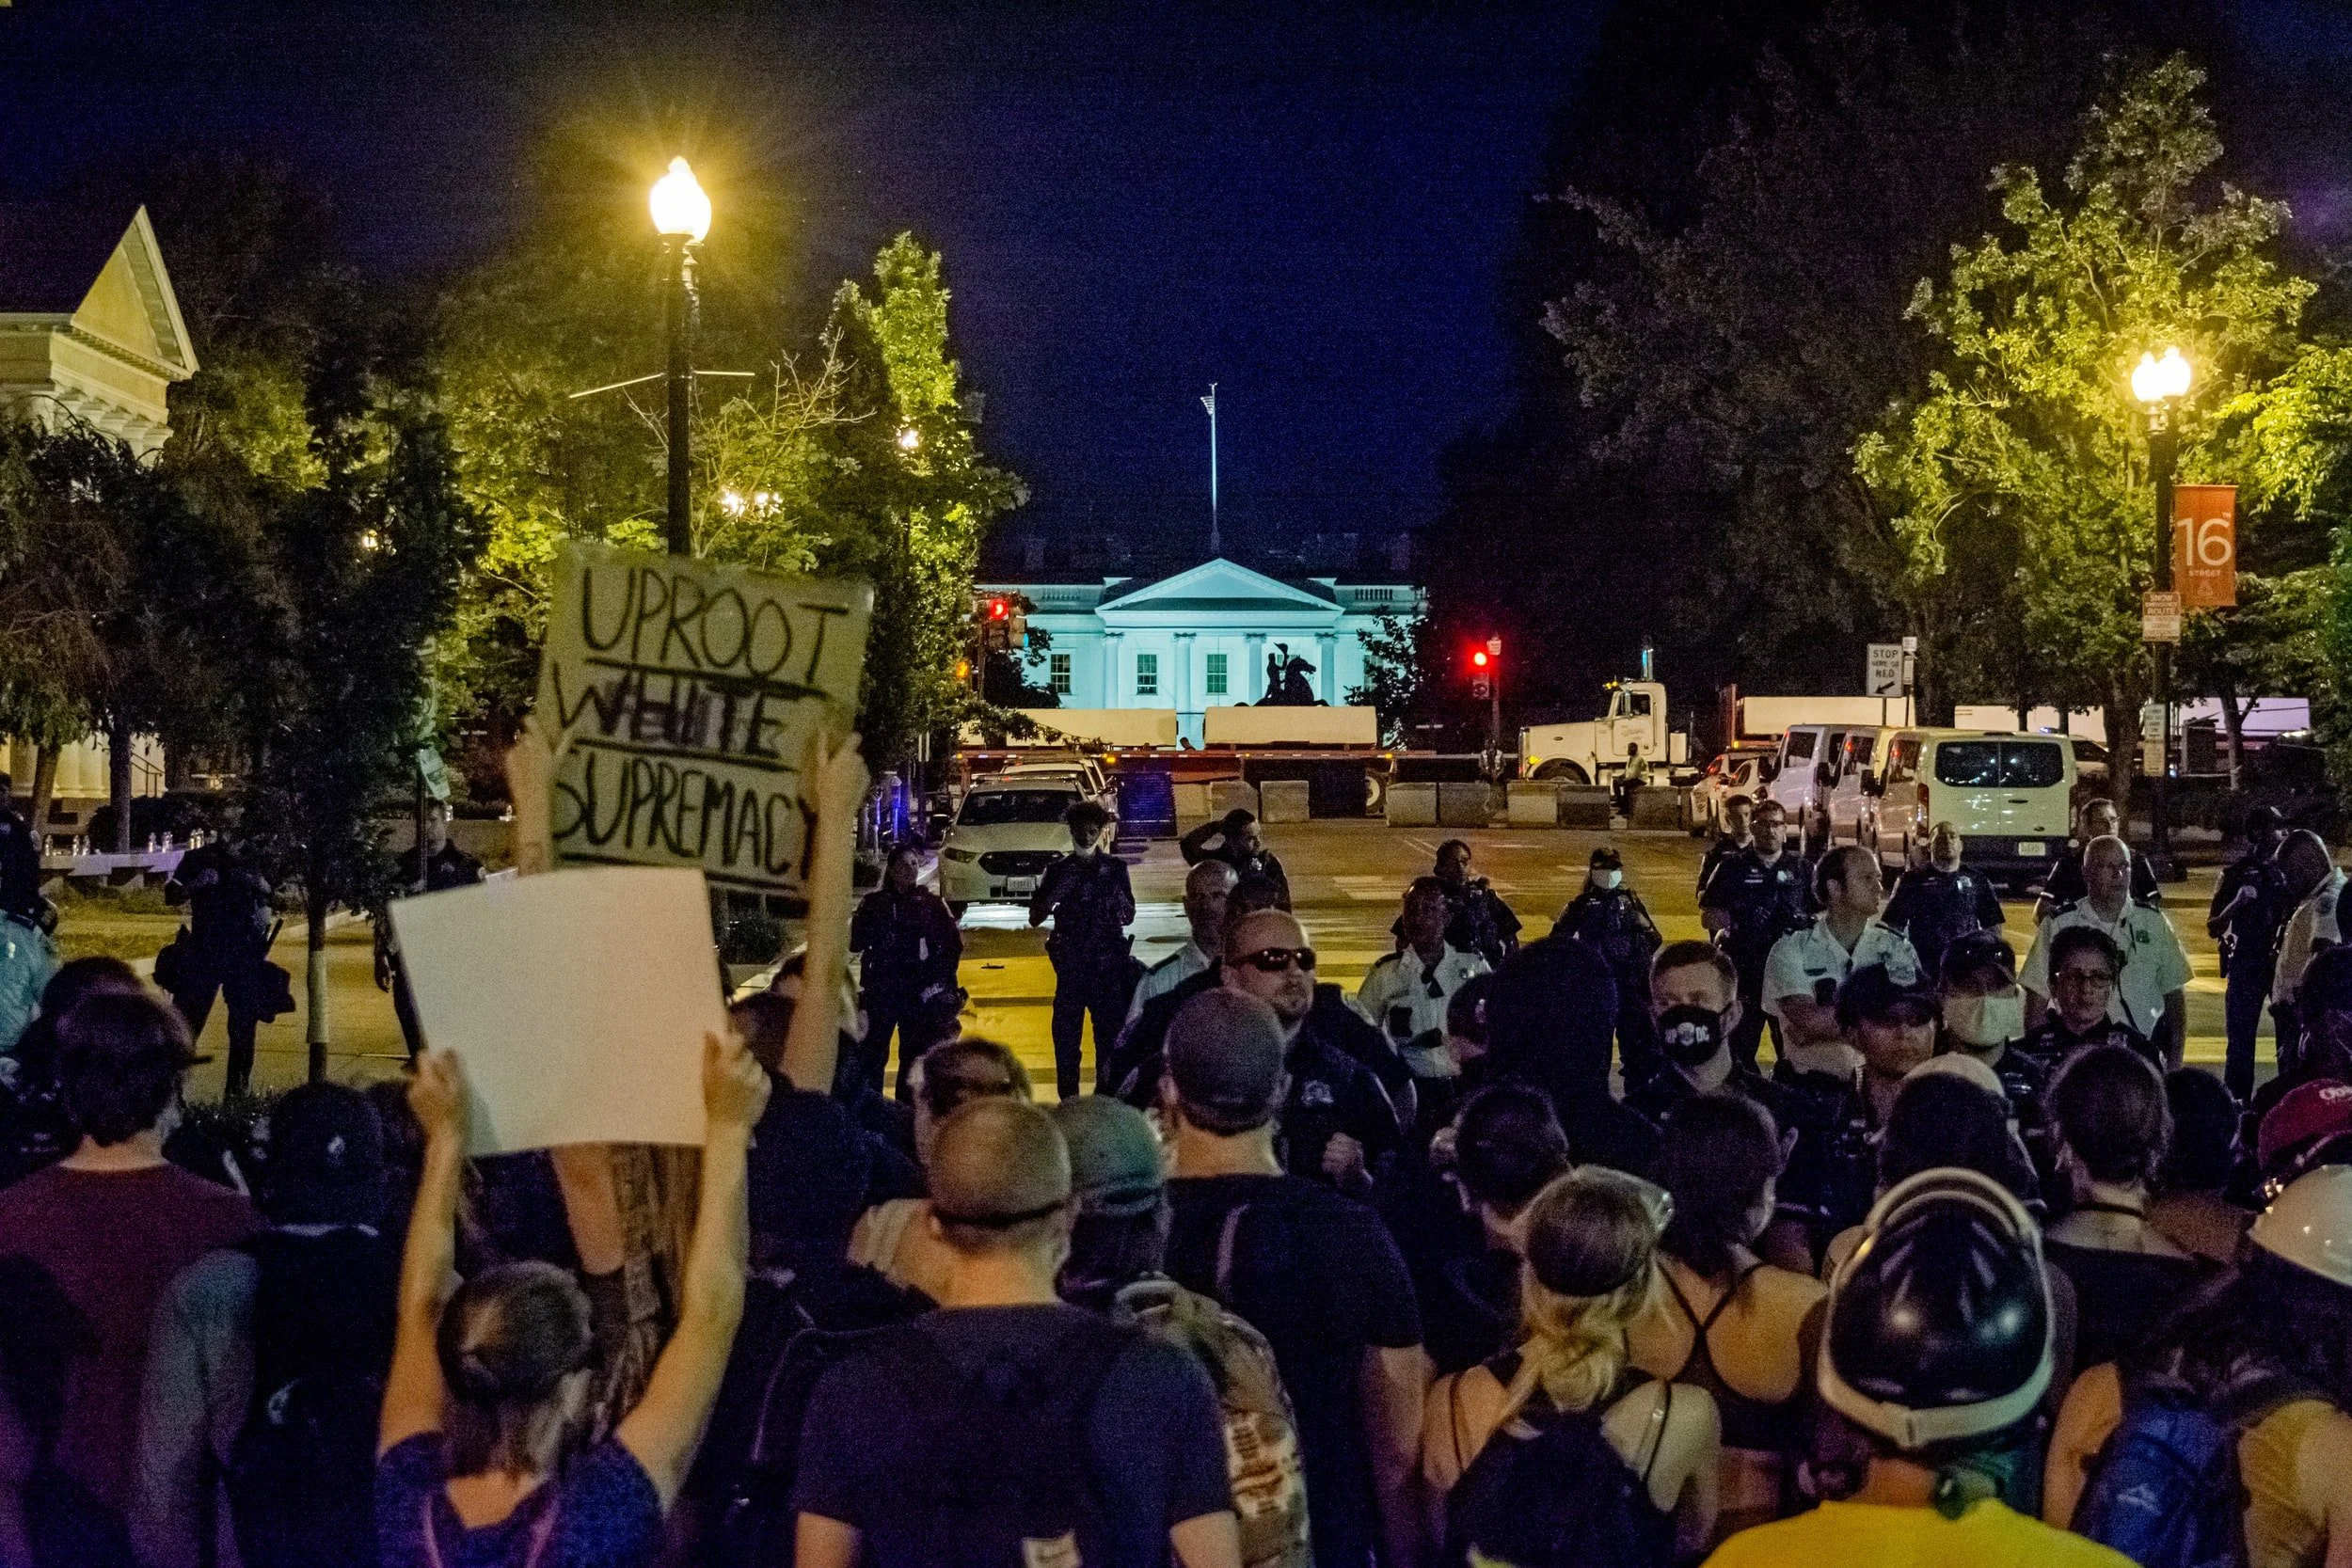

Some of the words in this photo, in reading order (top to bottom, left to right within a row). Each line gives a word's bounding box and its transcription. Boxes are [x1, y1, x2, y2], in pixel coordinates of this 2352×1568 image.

[582, 566, 849, 684] UPROOT
[1873, 649, 1899, 658] STOP
[551, 660, 785, 758] WHITE
[553, 752, 818, 880] SUPREMACY
